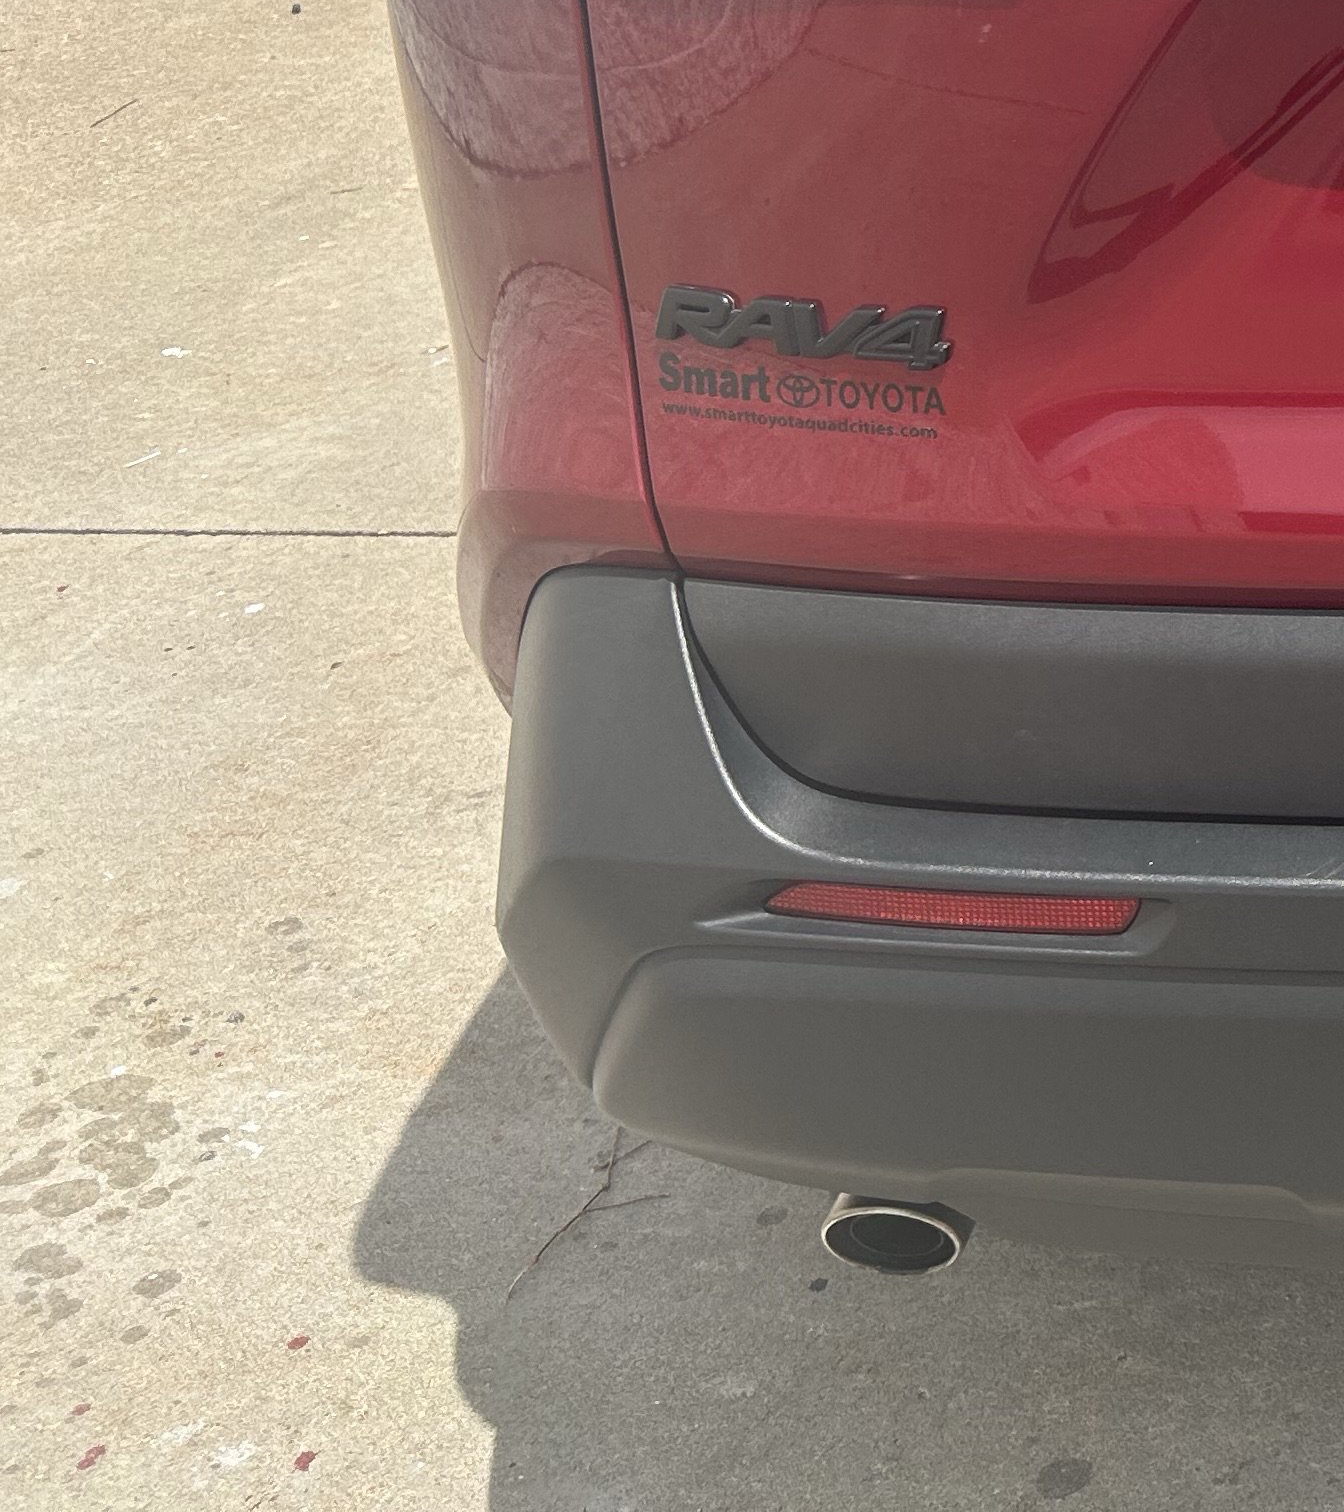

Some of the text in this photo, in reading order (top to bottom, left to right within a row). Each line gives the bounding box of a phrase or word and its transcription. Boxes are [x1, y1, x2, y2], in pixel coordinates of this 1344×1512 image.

[655, 284, 951, 371] RAV4
[658, 351, 947, 416] Smart TOYOTA
[662, 401, 939, 440] www.smarttoyotaquadcities.com
